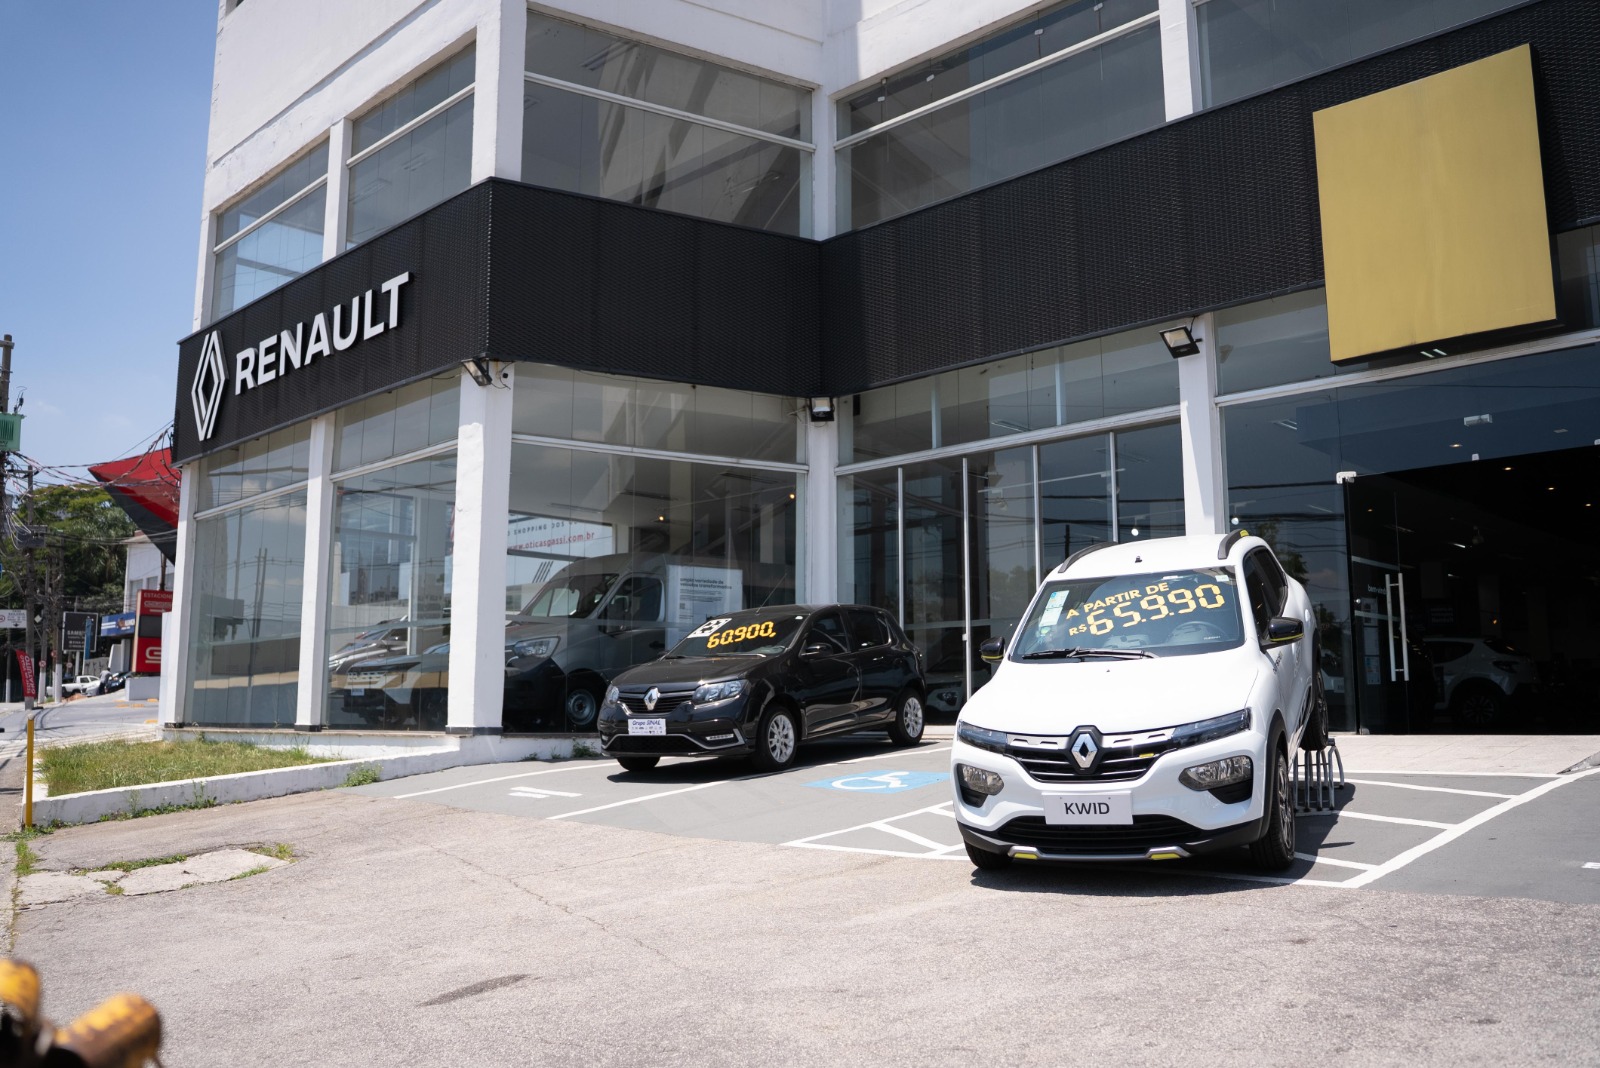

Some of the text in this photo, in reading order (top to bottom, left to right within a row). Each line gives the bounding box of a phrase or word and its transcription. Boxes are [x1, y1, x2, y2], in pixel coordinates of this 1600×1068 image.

[235, 271, 409, 396] RENAULT
[514, 524, 547, 535] SHOPPING
[1066, 582, 1170, 619] A PARTIR DE
[1068, 623, 1088, 636] R$
[24, 655, 36, 694] GRATUITO
[1063, 802, 1110, 815] KWID
